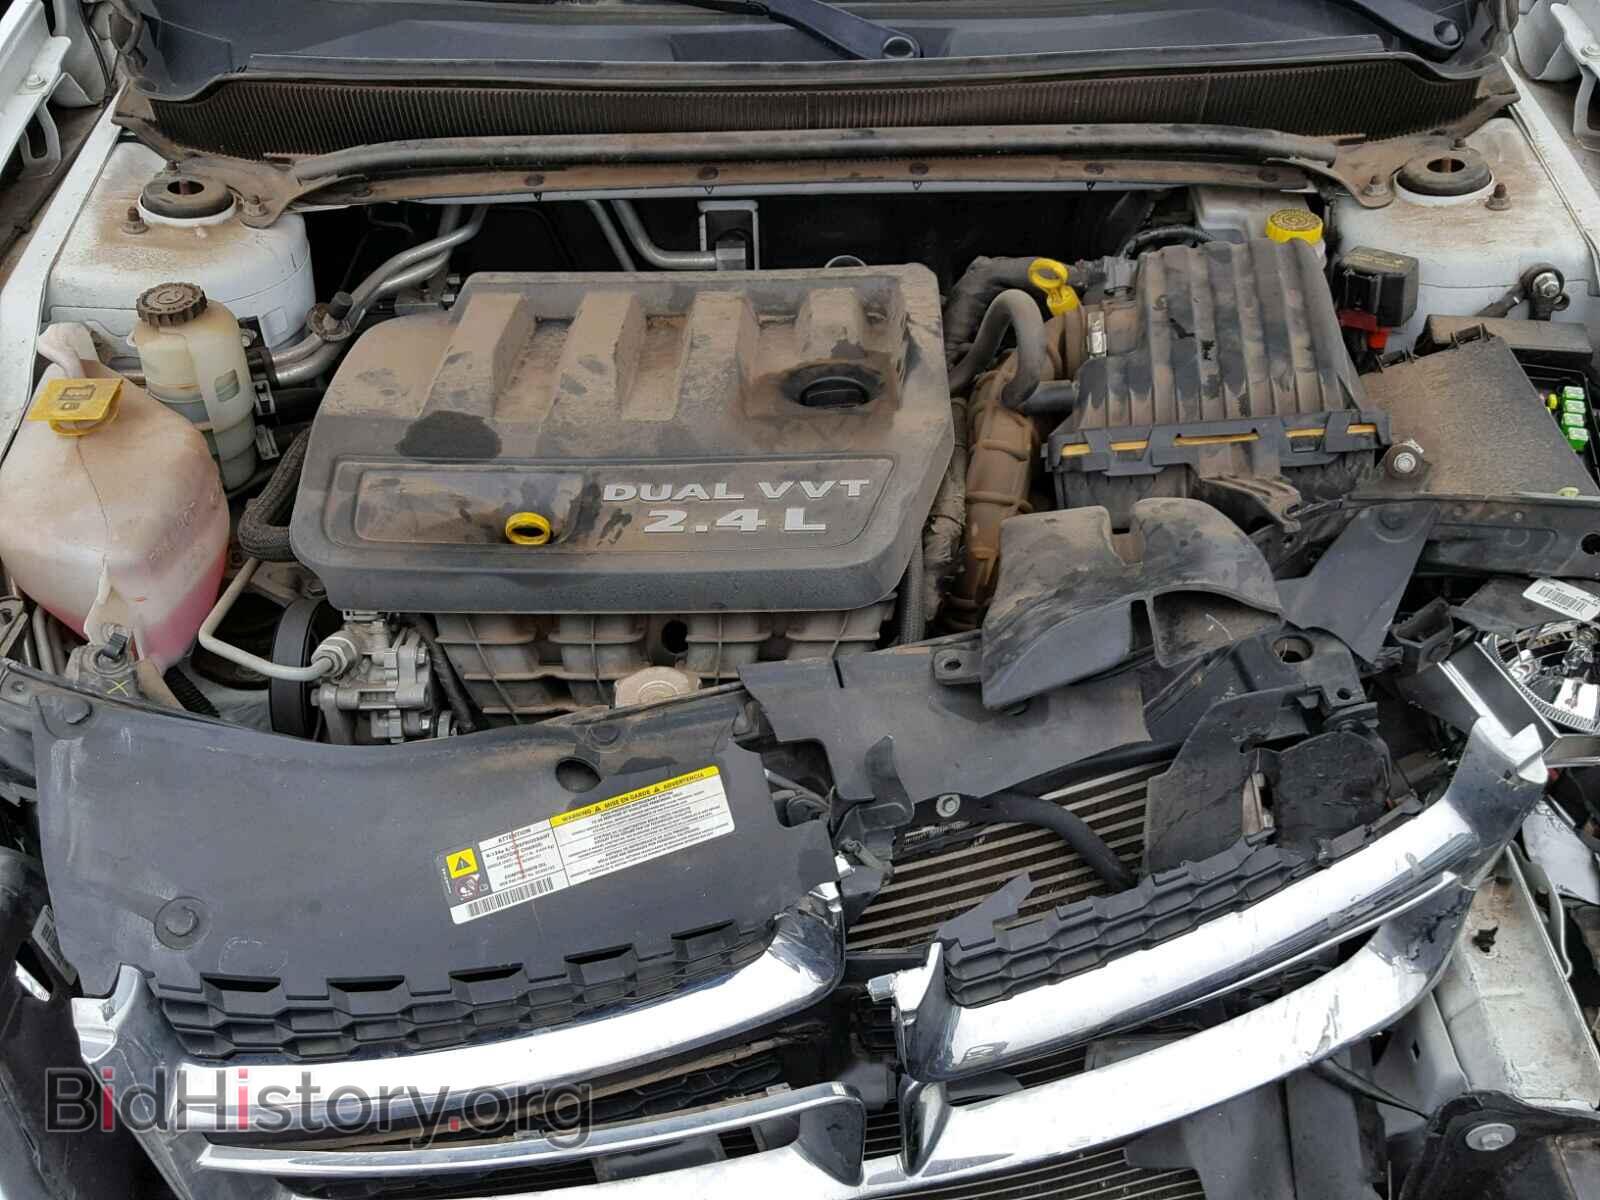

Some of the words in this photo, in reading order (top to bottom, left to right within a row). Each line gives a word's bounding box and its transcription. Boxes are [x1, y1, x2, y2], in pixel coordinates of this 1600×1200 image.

[603, 483, 744, 502] DUAL
[758, 480, 870, 499] VVT
[562, 808, 592, 822] WARNING
